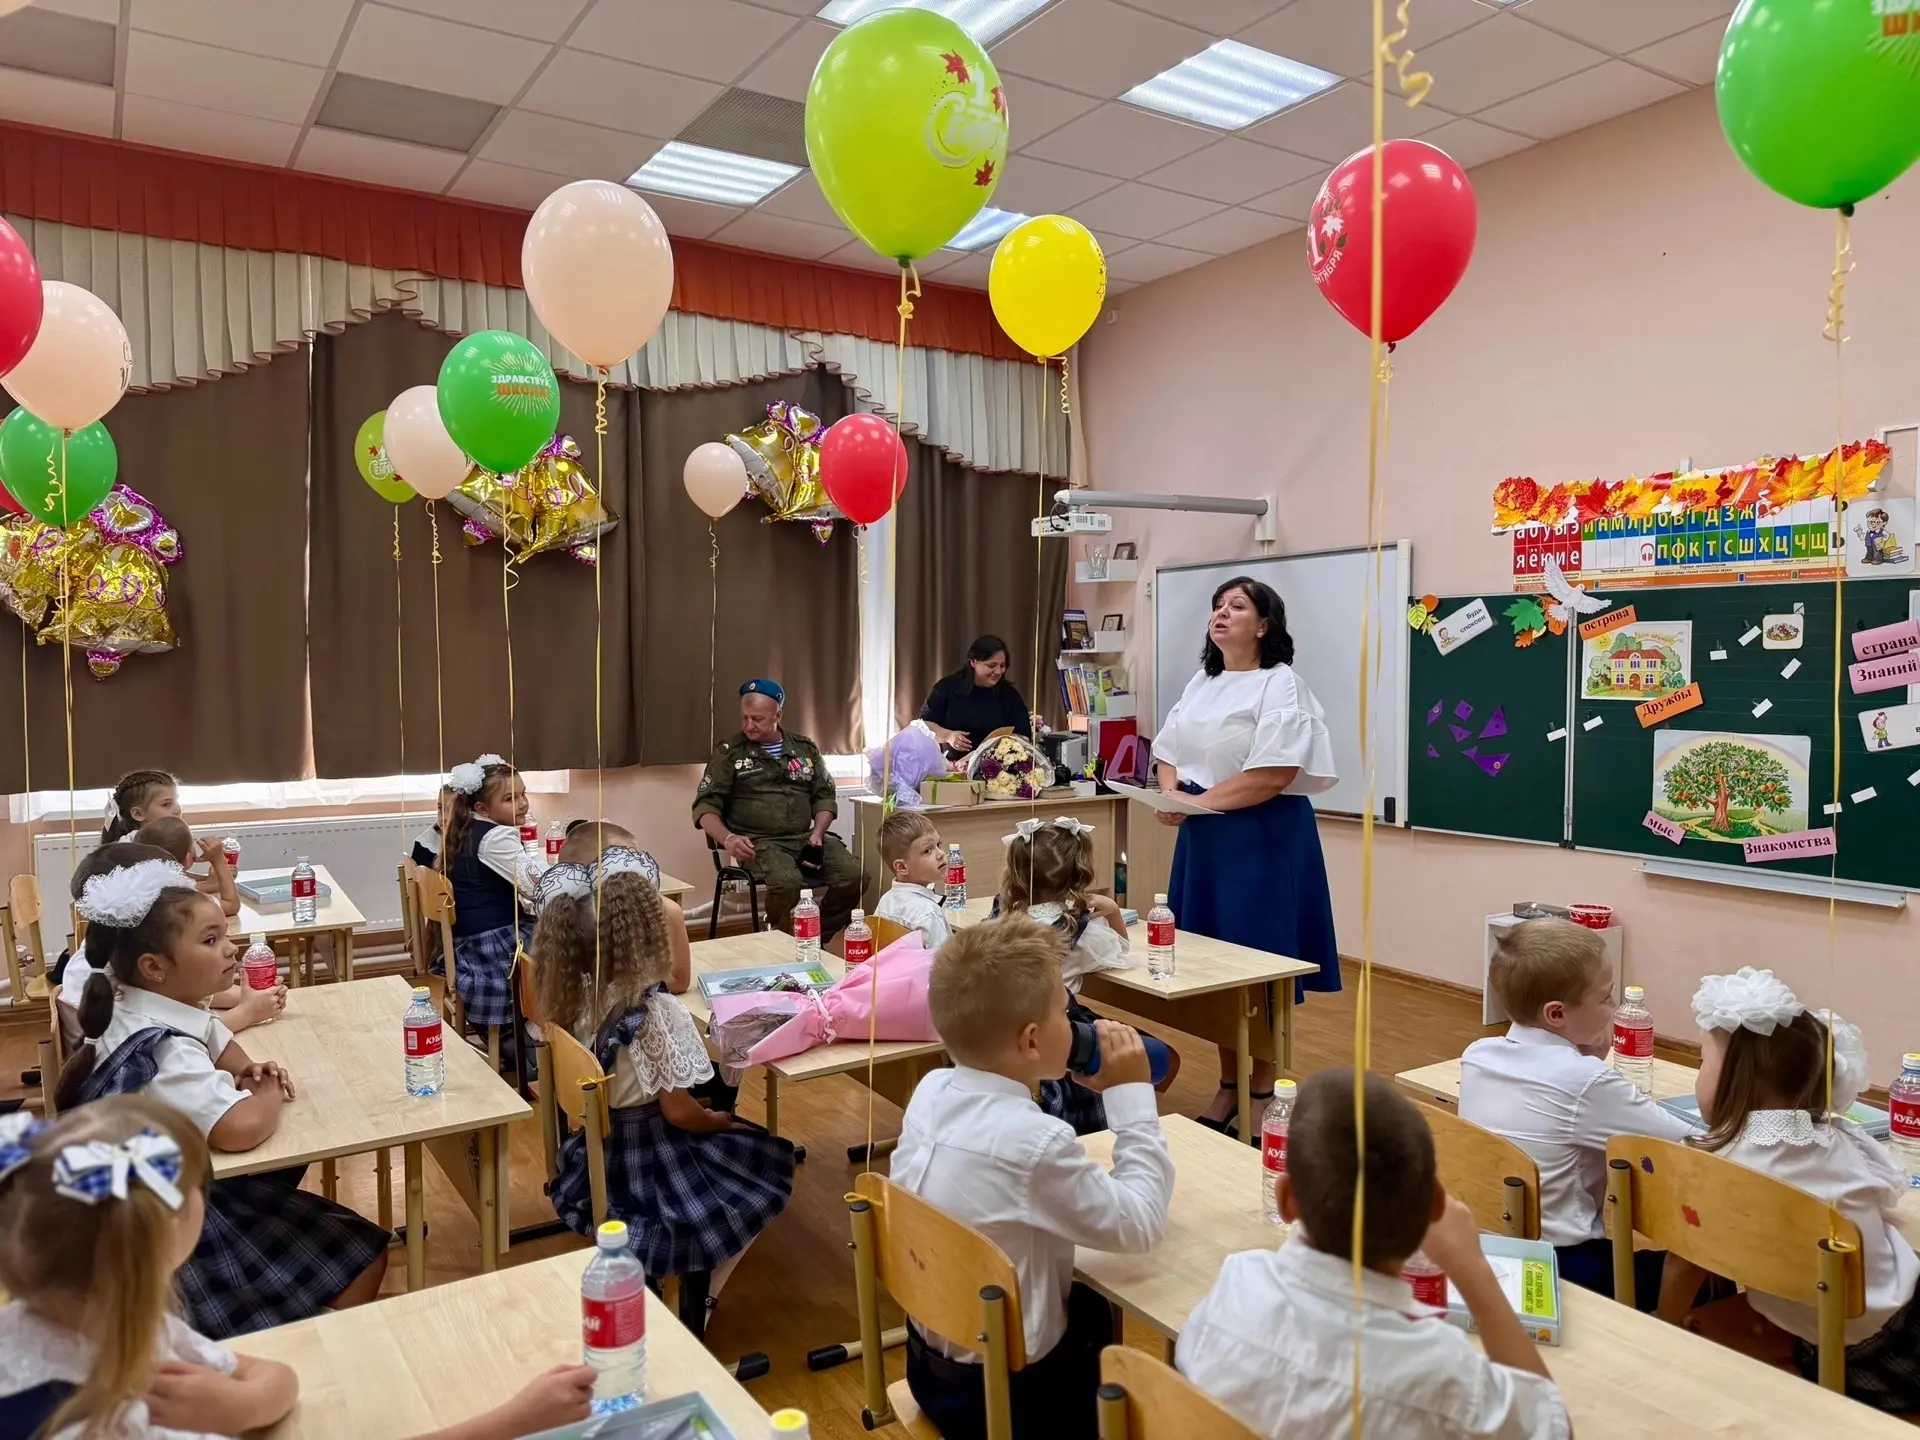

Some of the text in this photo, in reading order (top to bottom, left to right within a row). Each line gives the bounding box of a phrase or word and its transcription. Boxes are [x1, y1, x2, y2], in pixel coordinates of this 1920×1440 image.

[1466, 608, 1482, 619] Будь
[1584, 609, 1630, 632] острова
[1460, 615, 1486, 633] спокоен
[1862, 635, 1918, 656] страна
[1857, 659, 1918, 682] Знаний
[1643, 688, 1692, 718] Дружбы
[1648, 818, 1675, 838] мыс
[1745, 835, 1831, 855] Знакомства
[426, 1033, 442, 1045] КУБ
[1894, 1112, 1920, 1126] КУБА
[1268, 1147, 1287, 1159] КУБ
